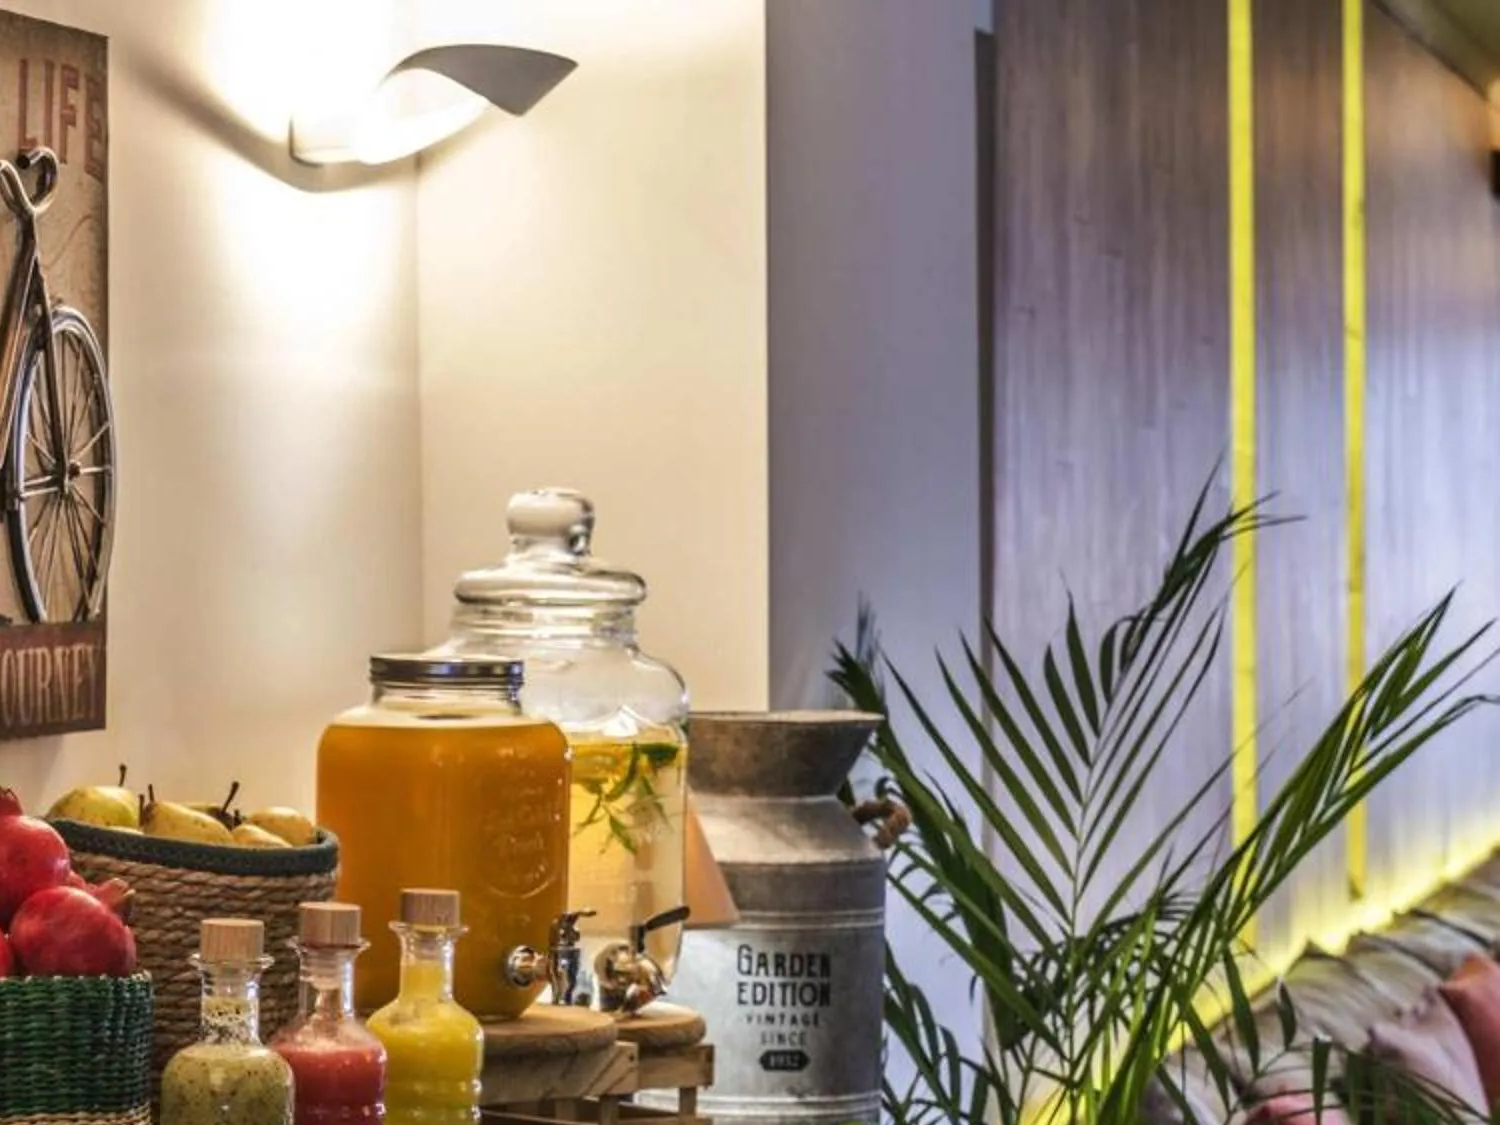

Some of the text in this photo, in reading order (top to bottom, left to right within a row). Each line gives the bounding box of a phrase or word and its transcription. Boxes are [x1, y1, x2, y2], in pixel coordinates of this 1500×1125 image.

[17, 59, 108, 184] LIFE
[737, 944, 831, 978] GARDEN
[737, 981, 831, 1008] EDITION
[746, 1012, 820, 1029] VINTAGE
[760, 1030, 808, 1048] SINCE
